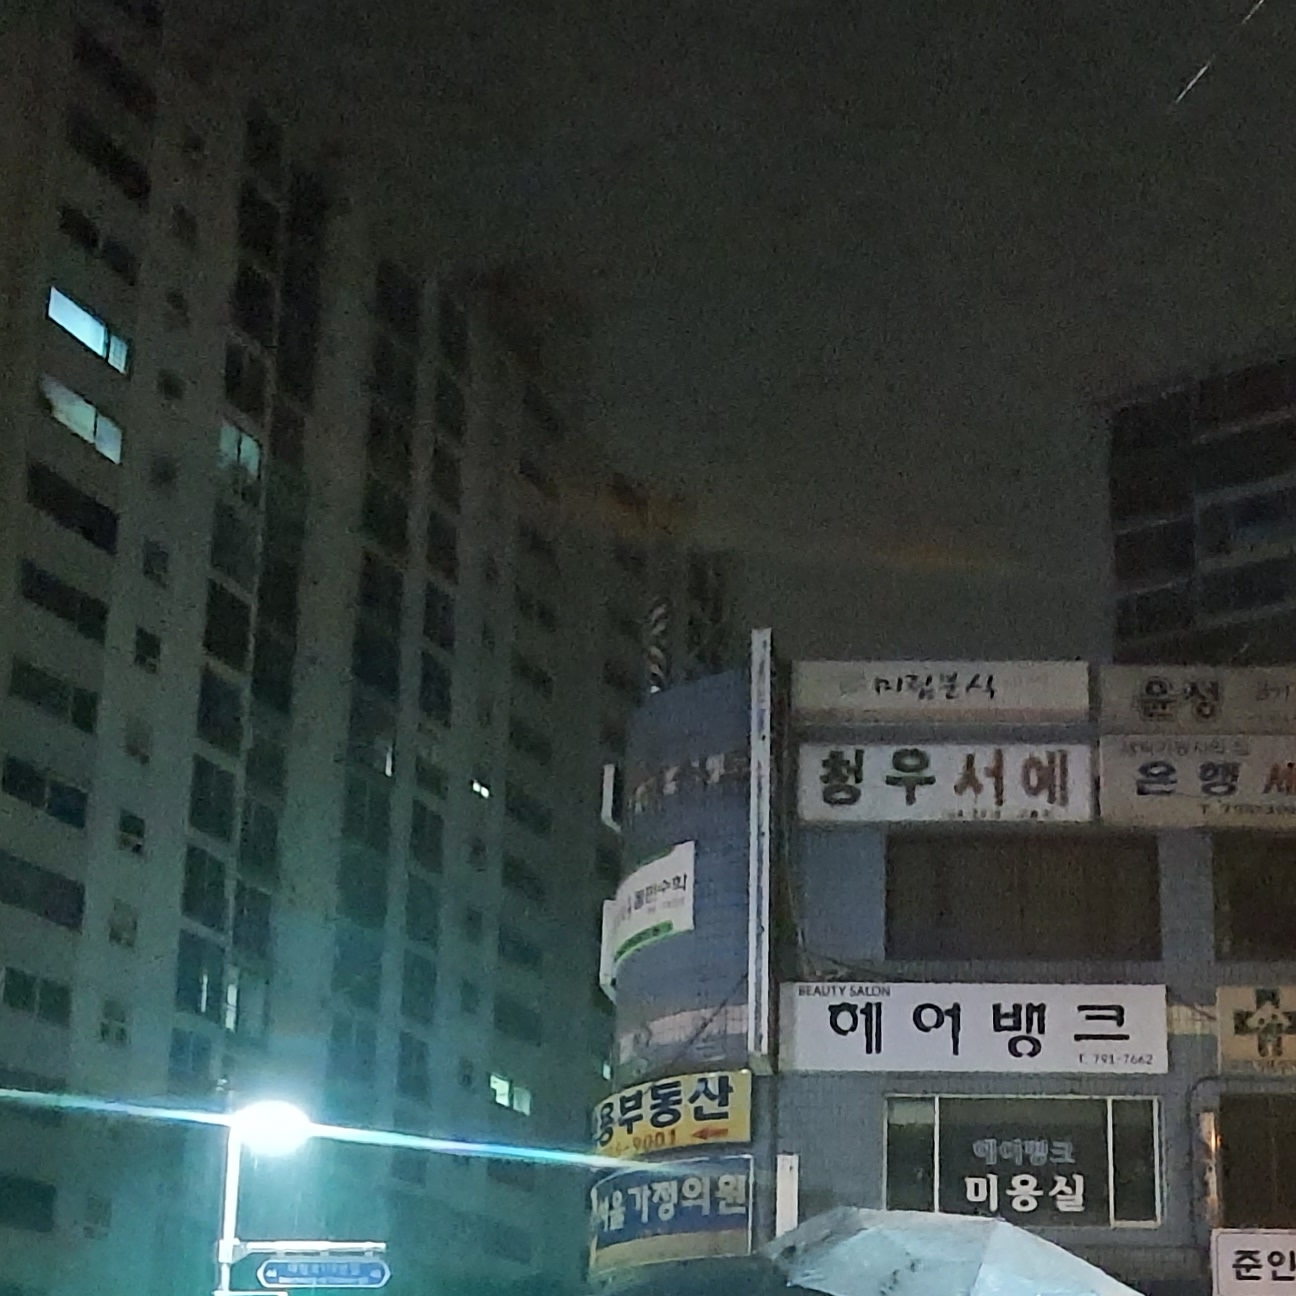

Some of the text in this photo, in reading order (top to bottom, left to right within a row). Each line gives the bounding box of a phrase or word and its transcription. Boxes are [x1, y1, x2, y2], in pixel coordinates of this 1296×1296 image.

[820, 748, 1068, 807] 청우서예
[799, 985, 891, 998] BEAUTY SALON
[828, 1001, 1130, 1058] 헤어뱅크
[964, 1173, 1086, 1212] 미용실
